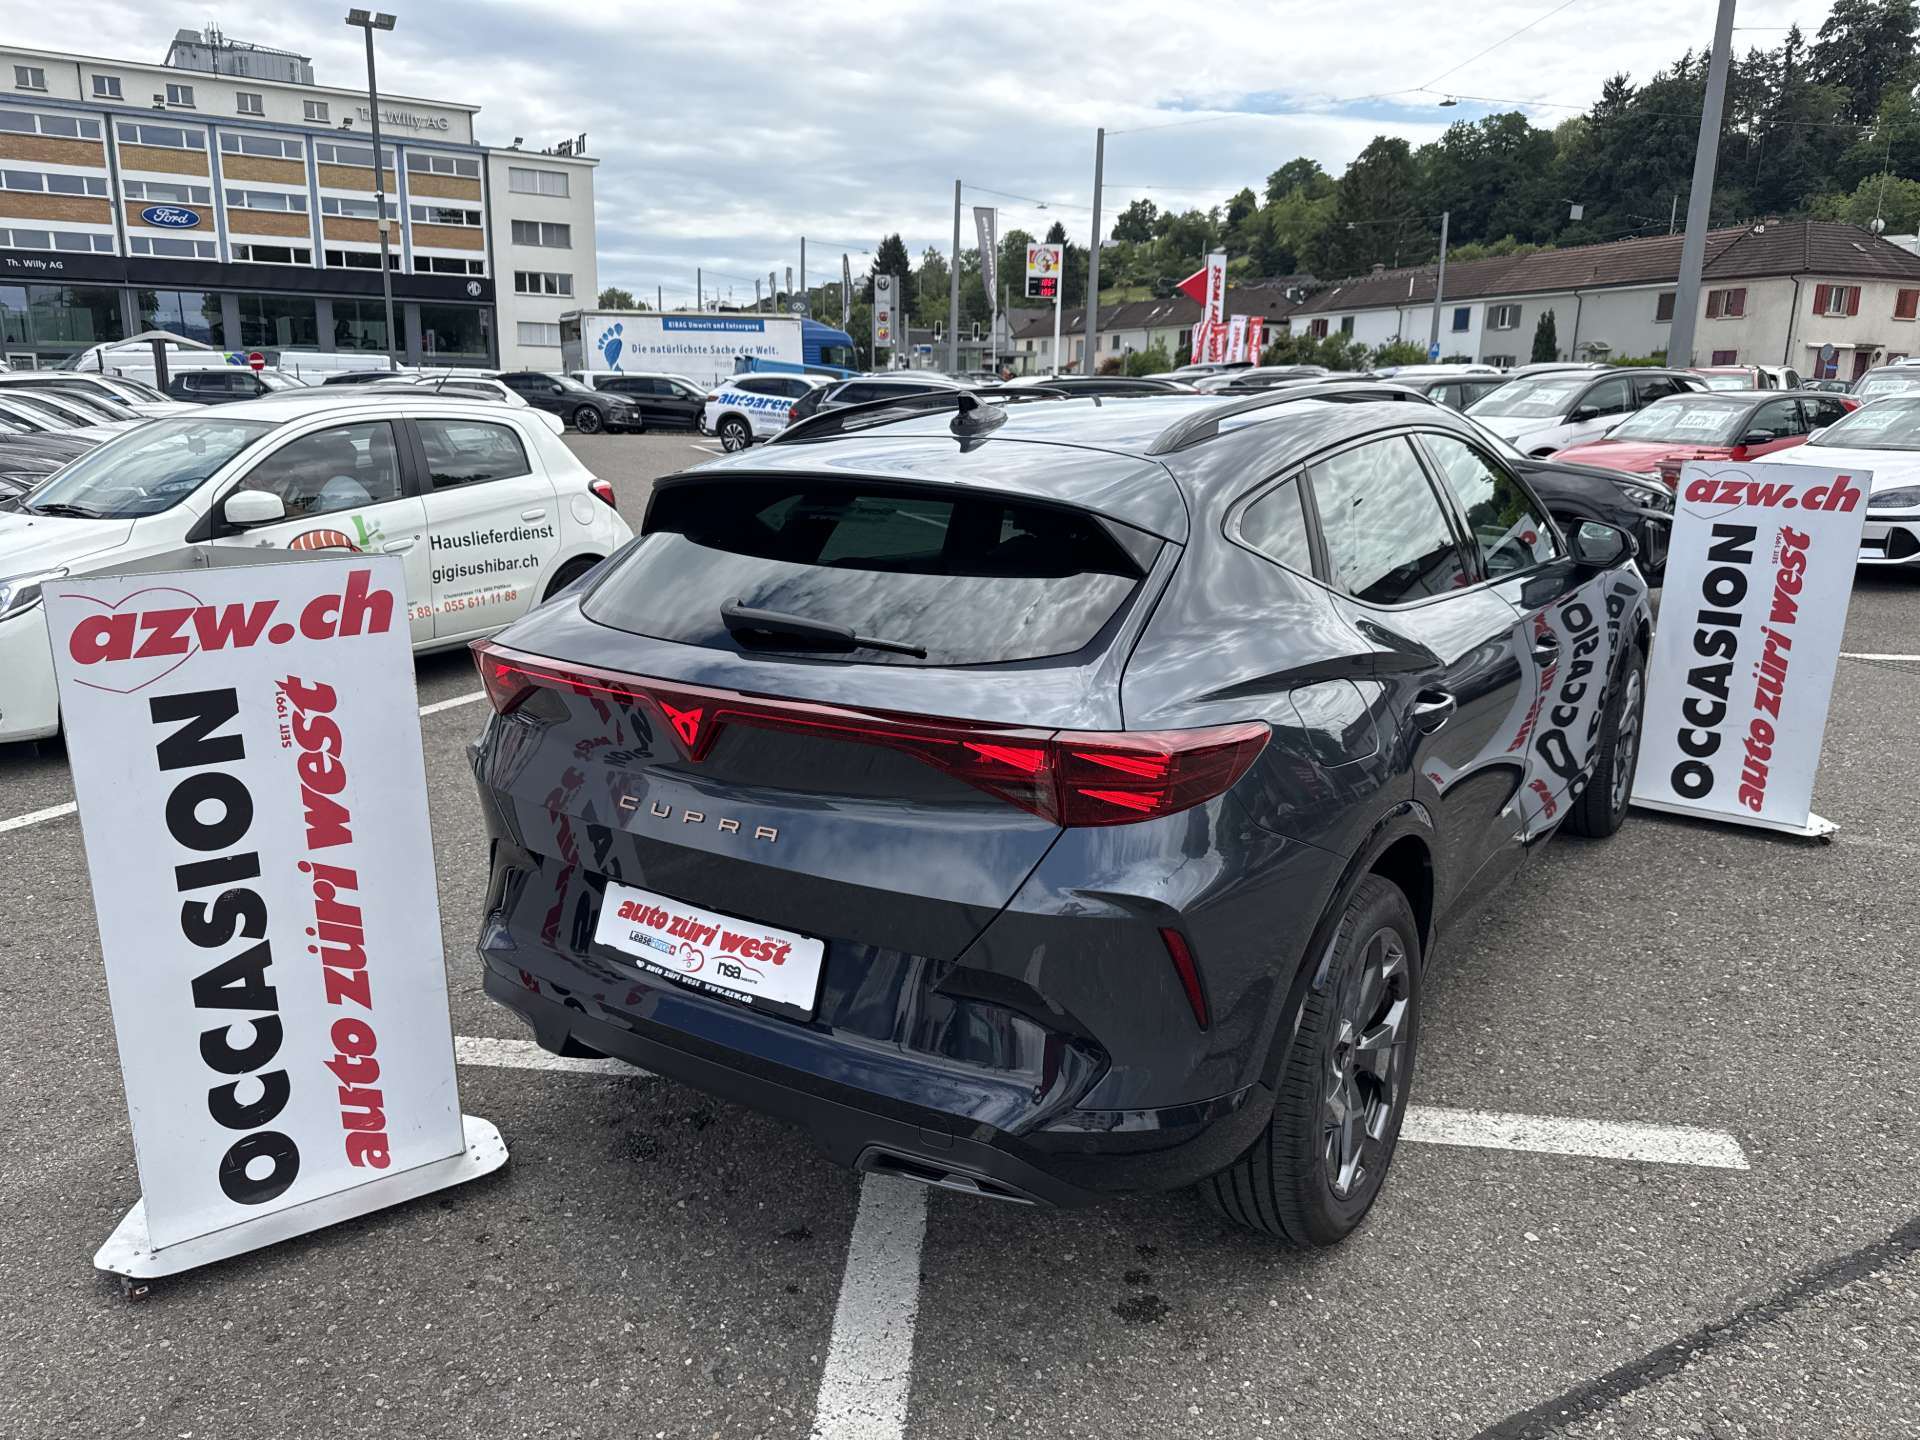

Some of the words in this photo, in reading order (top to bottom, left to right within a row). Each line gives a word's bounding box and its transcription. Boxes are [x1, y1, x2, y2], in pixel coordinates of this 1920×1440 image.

[386, 110, 422, 131] Willy
[426, 116, 449, 130] AG
[153, 207, 189, 224] Ford
[1754, 225, 1765, 233] 48
[6, 258, 21, 267] Th.
[23, 259, 47, 270] Willy
[49, 261, 64, 270] AG
[688, 321, 712, 329] Umwelt
[631, 344, 647, 353] Die
[650, 344, 708, 354] natürlichste
[710, 344, 736, 354] Sache
[738, 345, 754, 355] der
[755, 345, 780, 355] Welt.
[1685, 475, 1861, 512] azw.ch
[429, 524, 554, 551] Hauslieferdienst
[431, 554, 540, 584] gigisushibar.ch
[1772, 547, 1780, 564] SEIT
[1769, 525, 1811, 625] west
[68, 569, 394, 666] azw.ch
[416, 606, 431, 619] 88
[444, 599, 465, 613] 055
[468, 596, 486, 609] 611
[491, 593, 501, 605] 11
[504, 590, 517, 601] 88
[1670, 523, 1757, 800] OCCASION
[1752, 625, 1792, 721] züri
[276, 690, 288, 720] 1991
[280, 722, 293, 748] SEIT
[274, 674, 353, 851] west
[1738, 718, 1775, 813] auto
[619, 794, 779, 843] CUPRA
[149, 687, 301, 1205] OCCASION
[297, 860, 373, 1010] züri
[617, 900, 670, 930] auto
[666, 915, 721, 948] züri
[719, 930, 793, 966] west
[646, 964, 663, 974] auto
[682, 976, 701, 987] west
[704, 983, 753, 1004] www.azw.ch
[717, 961, 741, 980] nsa
[323, 1018, 391, 1170] auto
